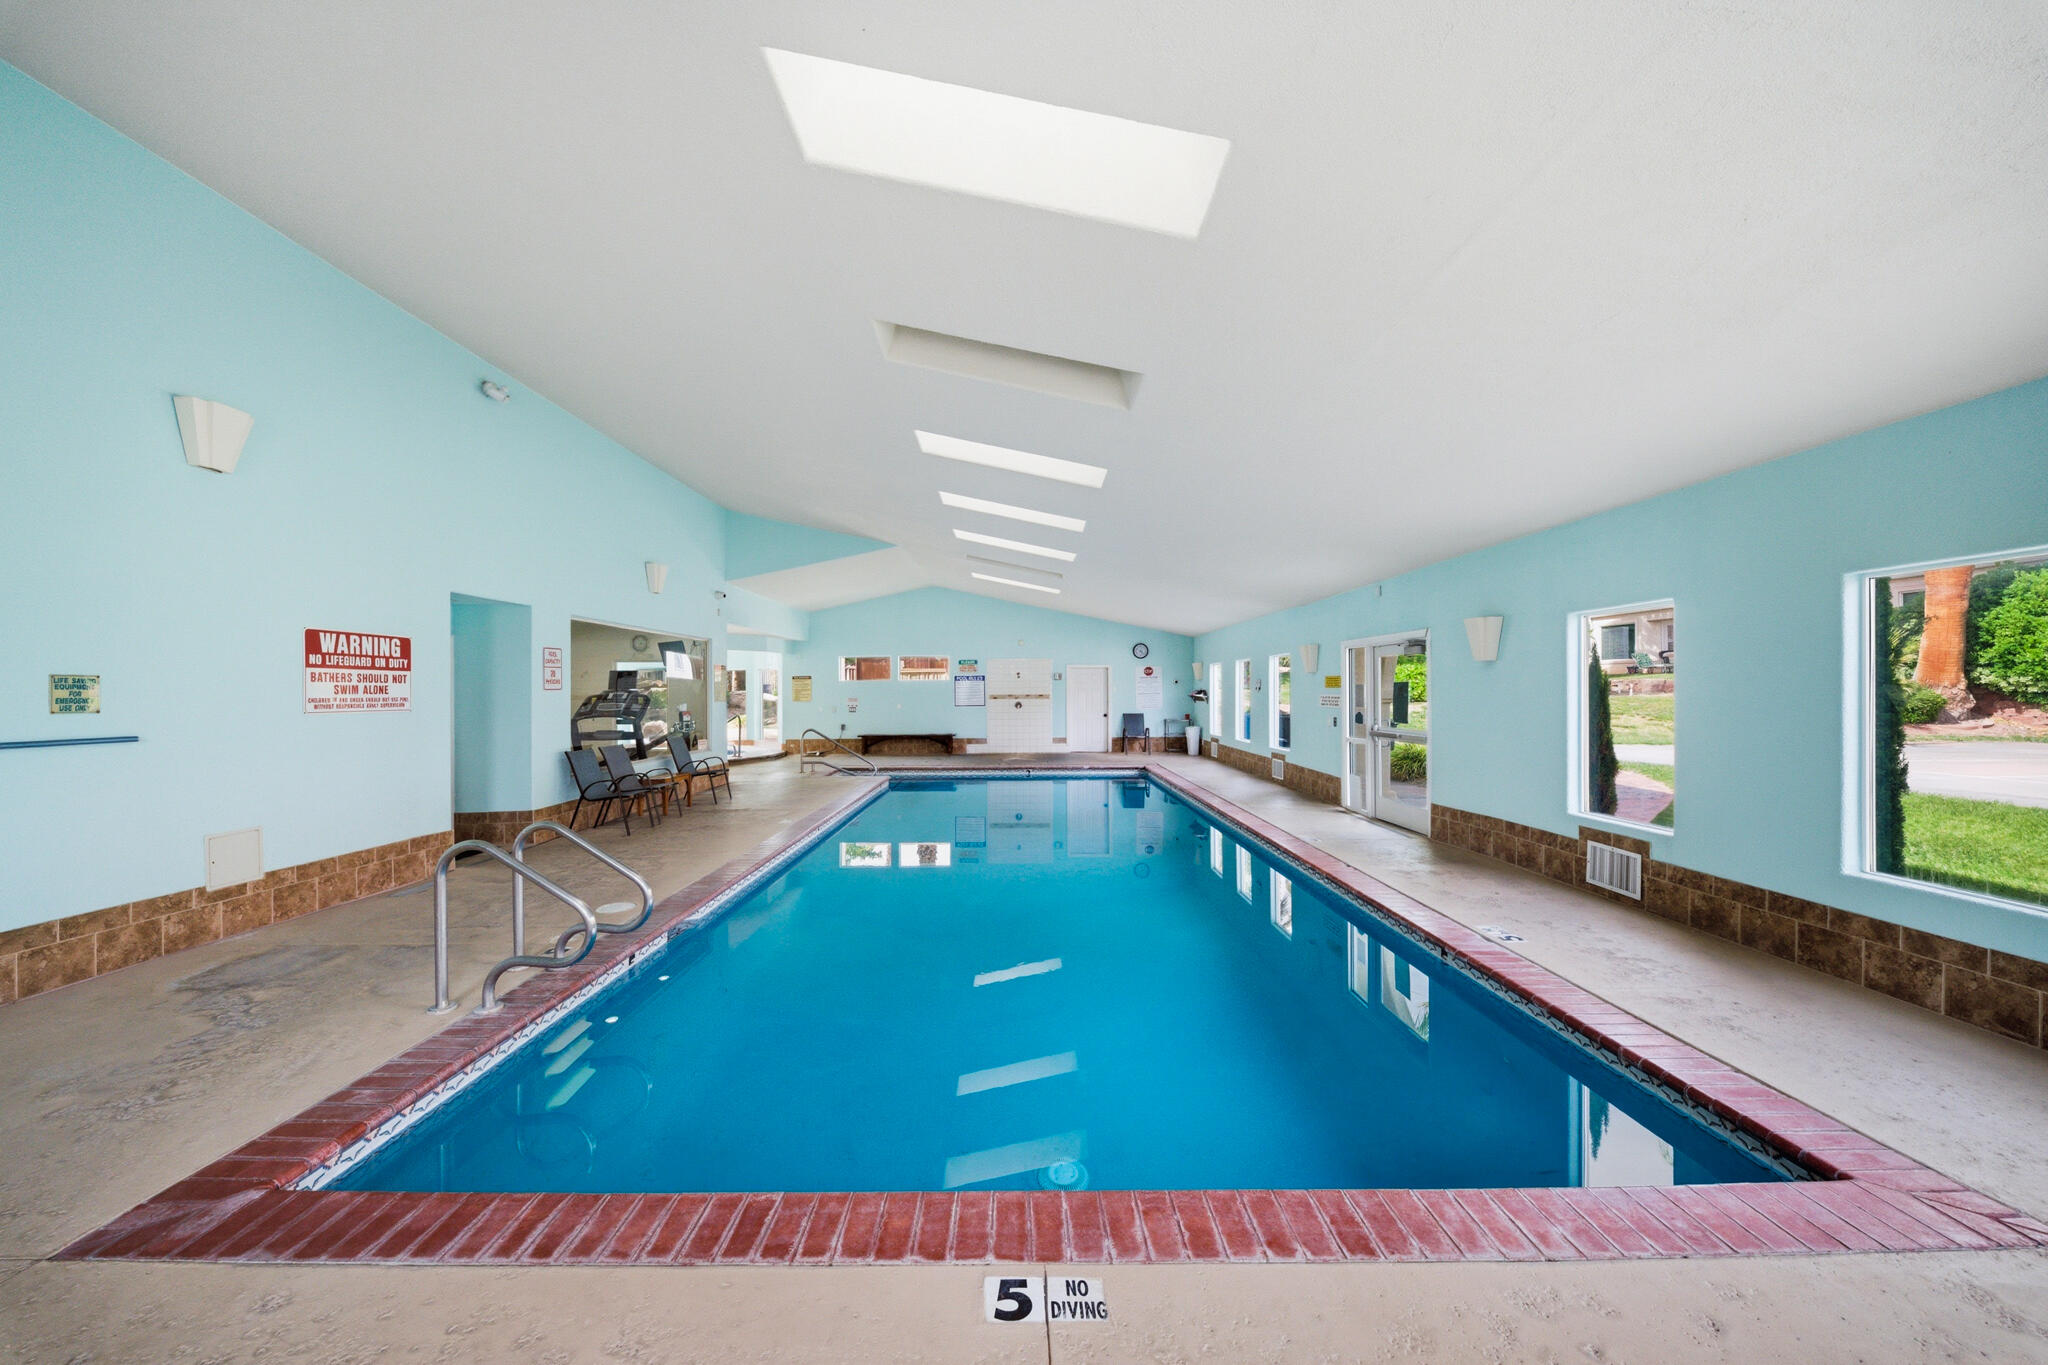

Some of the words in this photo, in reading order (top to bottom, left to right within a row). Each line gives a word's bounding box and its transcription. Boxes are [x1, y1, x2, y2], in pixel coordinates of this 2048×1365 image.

[319, 632, 401, 657] WARNING
[309, 654, 322, 664] NO
[326, 655, 372, 667] LIFEGUARD
[375, 658, 385, 668] ON
[389, 659, 408, 668] DUTY
[310, 672, 353, 683] BATHERS
[357, 673, 389, 684] SHOULD
[392, 674, 407, 684] NOT
[334, 685, 359, 695] SWIM
[363, 685, 389, 695] ALONE
[1065, 1279, 1089, 1297] NO
[994, 1279, 1033, 1321] 5
[1051, 1301, 1108, 1320] DIVING
